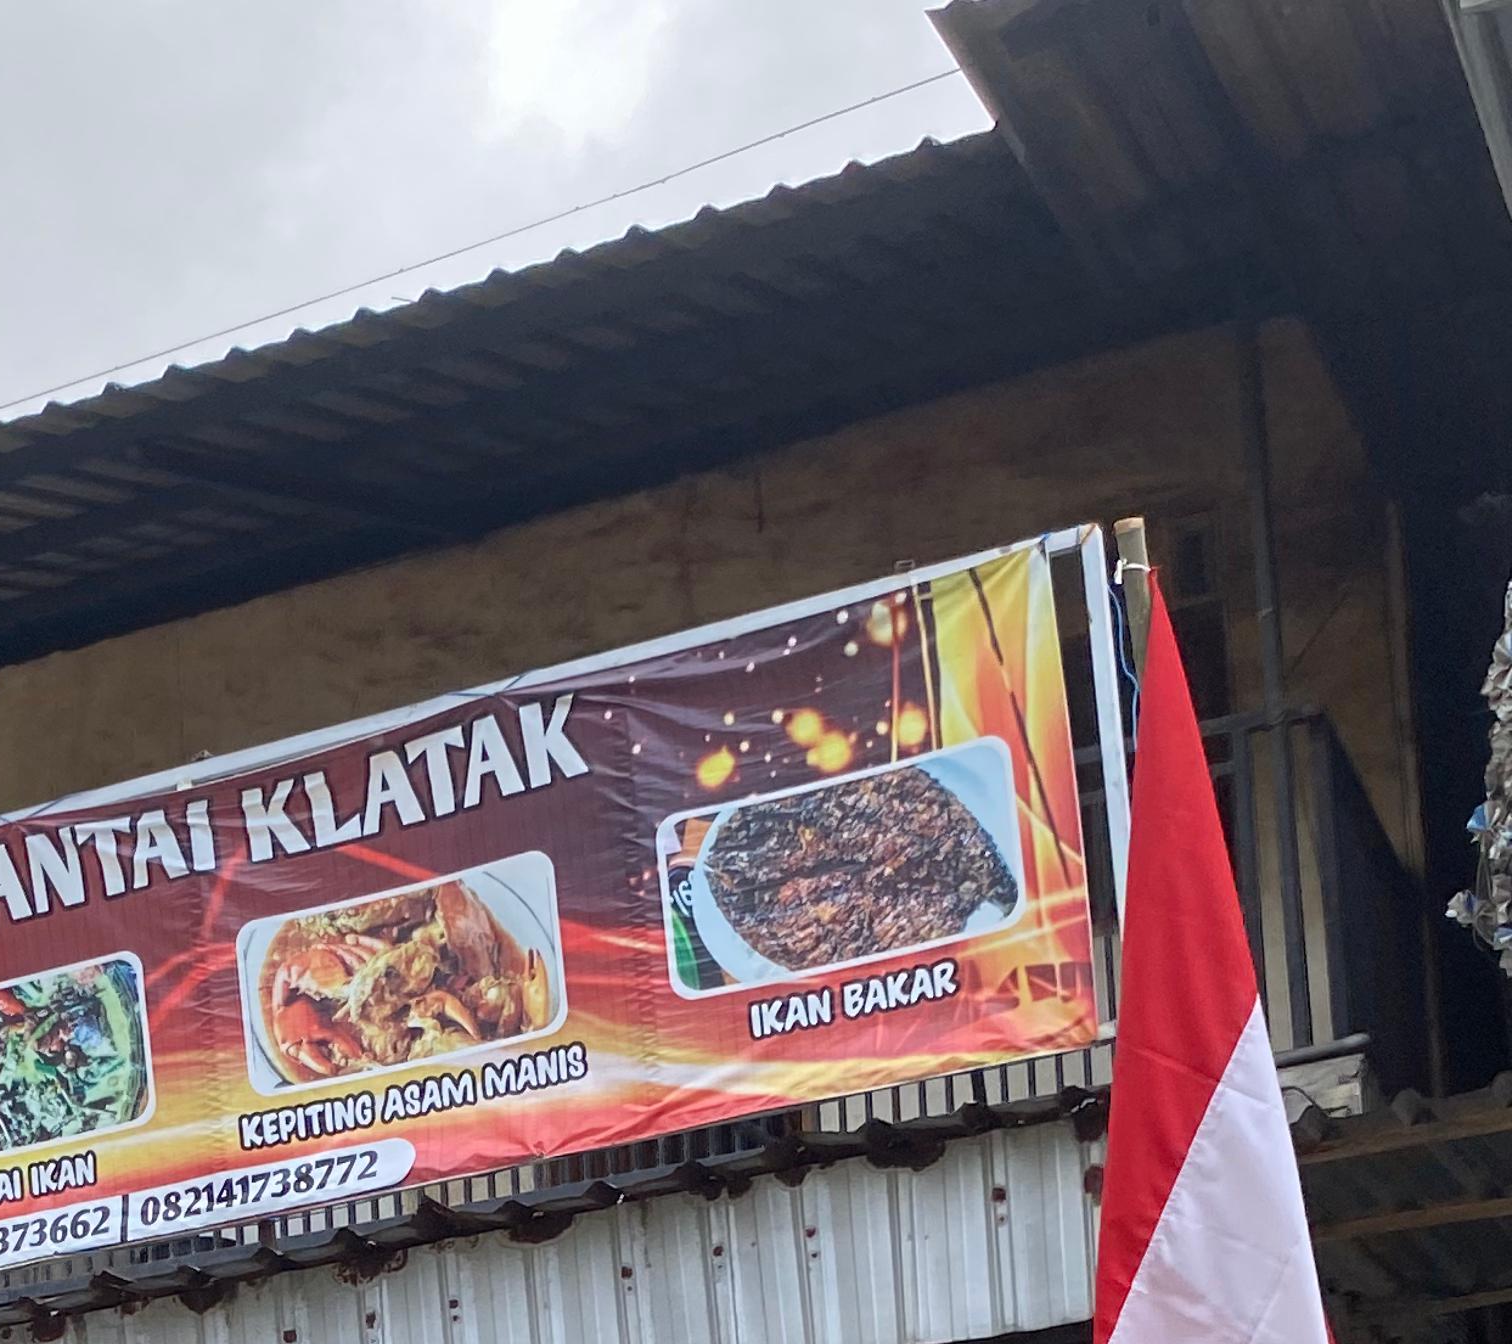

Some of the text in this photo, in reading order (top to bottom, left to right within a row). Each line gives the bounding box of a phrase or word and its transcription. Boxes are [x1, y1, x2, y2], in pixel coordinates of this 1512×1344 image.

[240, 694, 589, 862] KLATAK
[749, 960, 959, 1038] IKAN BAKAR
[239, 1043, 587, 1149] KEPITING ASAM MANIS
[30, 1152, 96, 1196] IKAN
[140, 1150, 380, 1225] 082141738772
